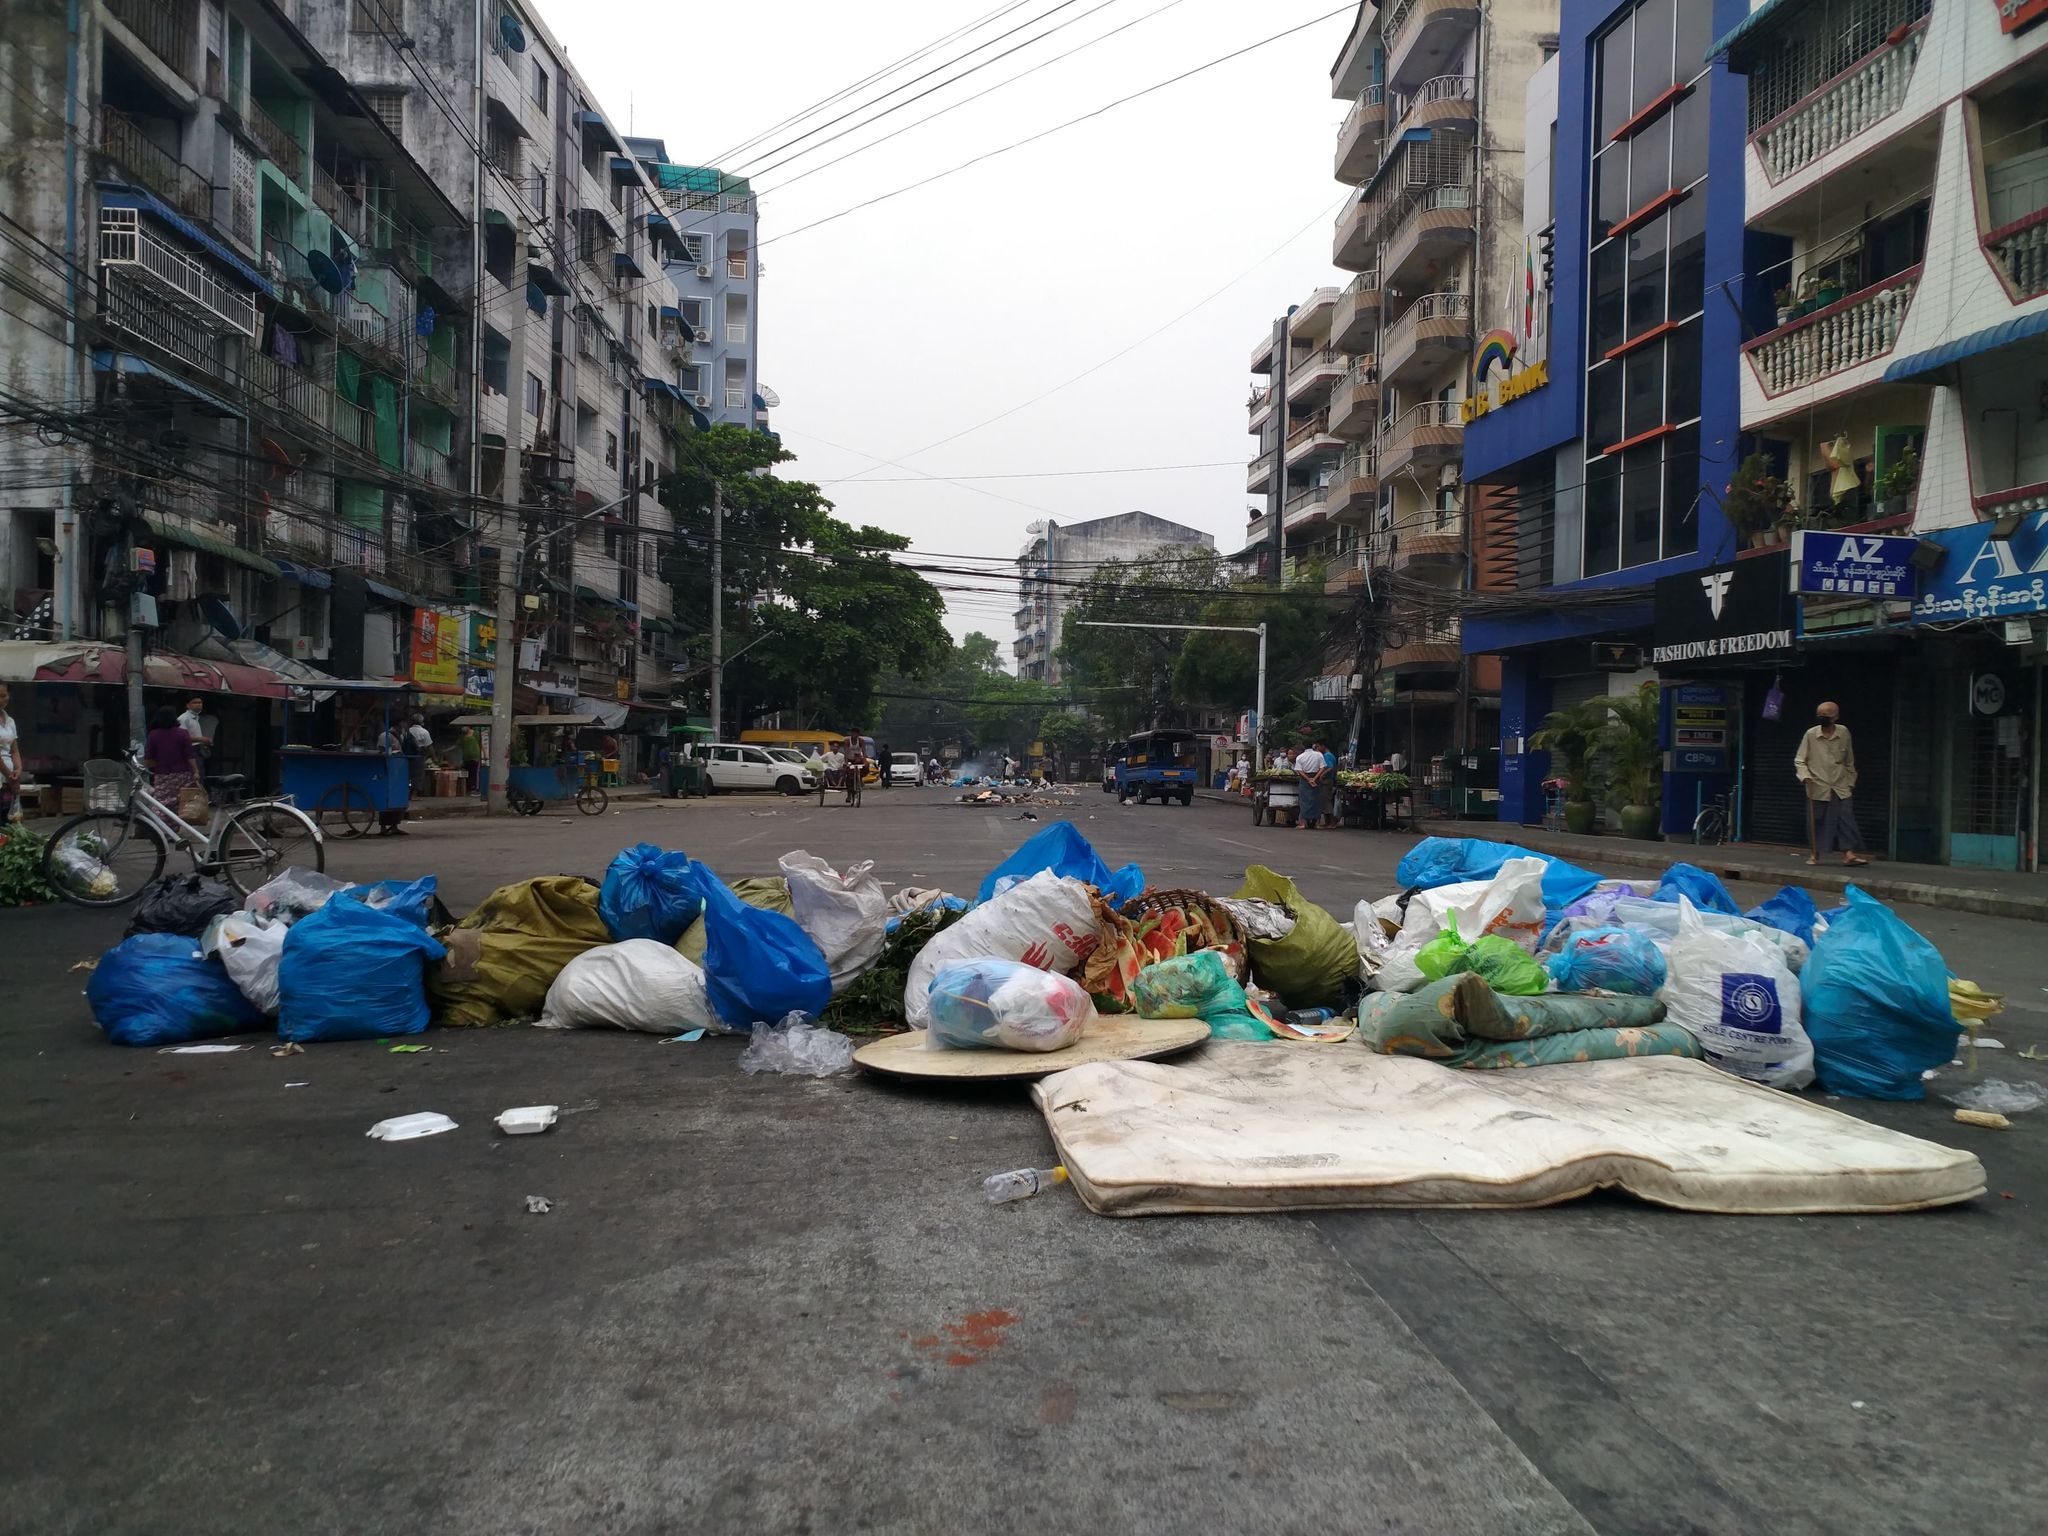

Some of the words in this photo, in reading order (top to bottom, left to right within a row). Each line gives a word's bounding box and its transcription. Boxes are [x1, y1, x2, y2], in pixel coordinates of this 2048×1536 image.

[1499, 360, 1549, 405] BANK
[1837, 537, 1884, 564] AZ
[1653, 641, 1706, 663] FASHION
[1707, 640, 1717, 656] &
[1720, 630, 1792, 655] FREEDOM
[1728, 1030, 1768, 1044] CENTRE
